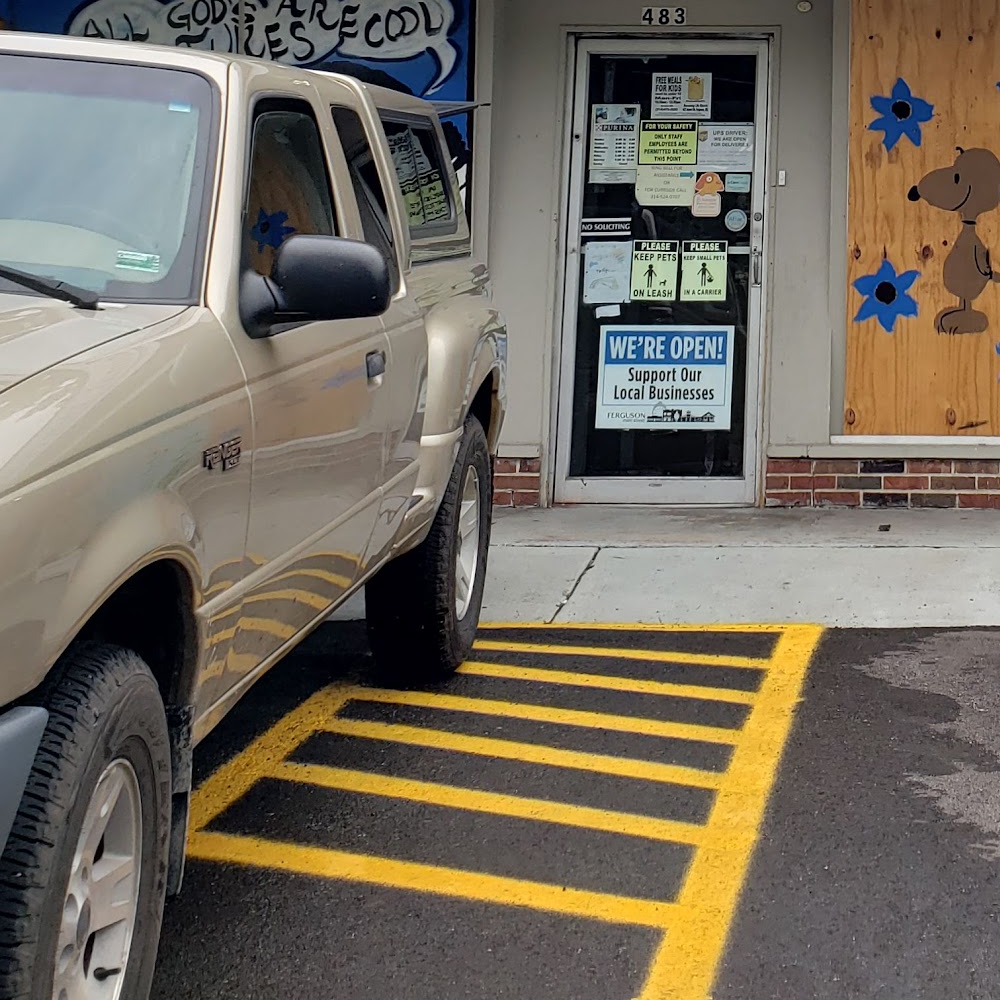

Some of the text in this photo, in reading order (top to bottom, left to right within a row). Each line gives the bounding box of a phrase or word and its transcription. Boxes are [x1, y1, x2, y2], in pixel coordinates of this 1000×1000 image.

[642, 7, 685, 25] 483
[83, 13, 150, 42] ALL
[364, 1, 445, 48] COOL
[656, 76, 667, 84] FREE
[656, 84, 682, 92] FOR KIDS
[641, 242, 671, 251] PLEASE
[690, 242, 720, 251] PLEASE
[634, 253, 676, 261] KEEP PETS
[633, 289, 644, 297] ON
[609, 336, 724, 360] WE'RE OPEN!
[628, 367, 702, 384] Support Our
[614, 385, 714, 400] Local Businesses
